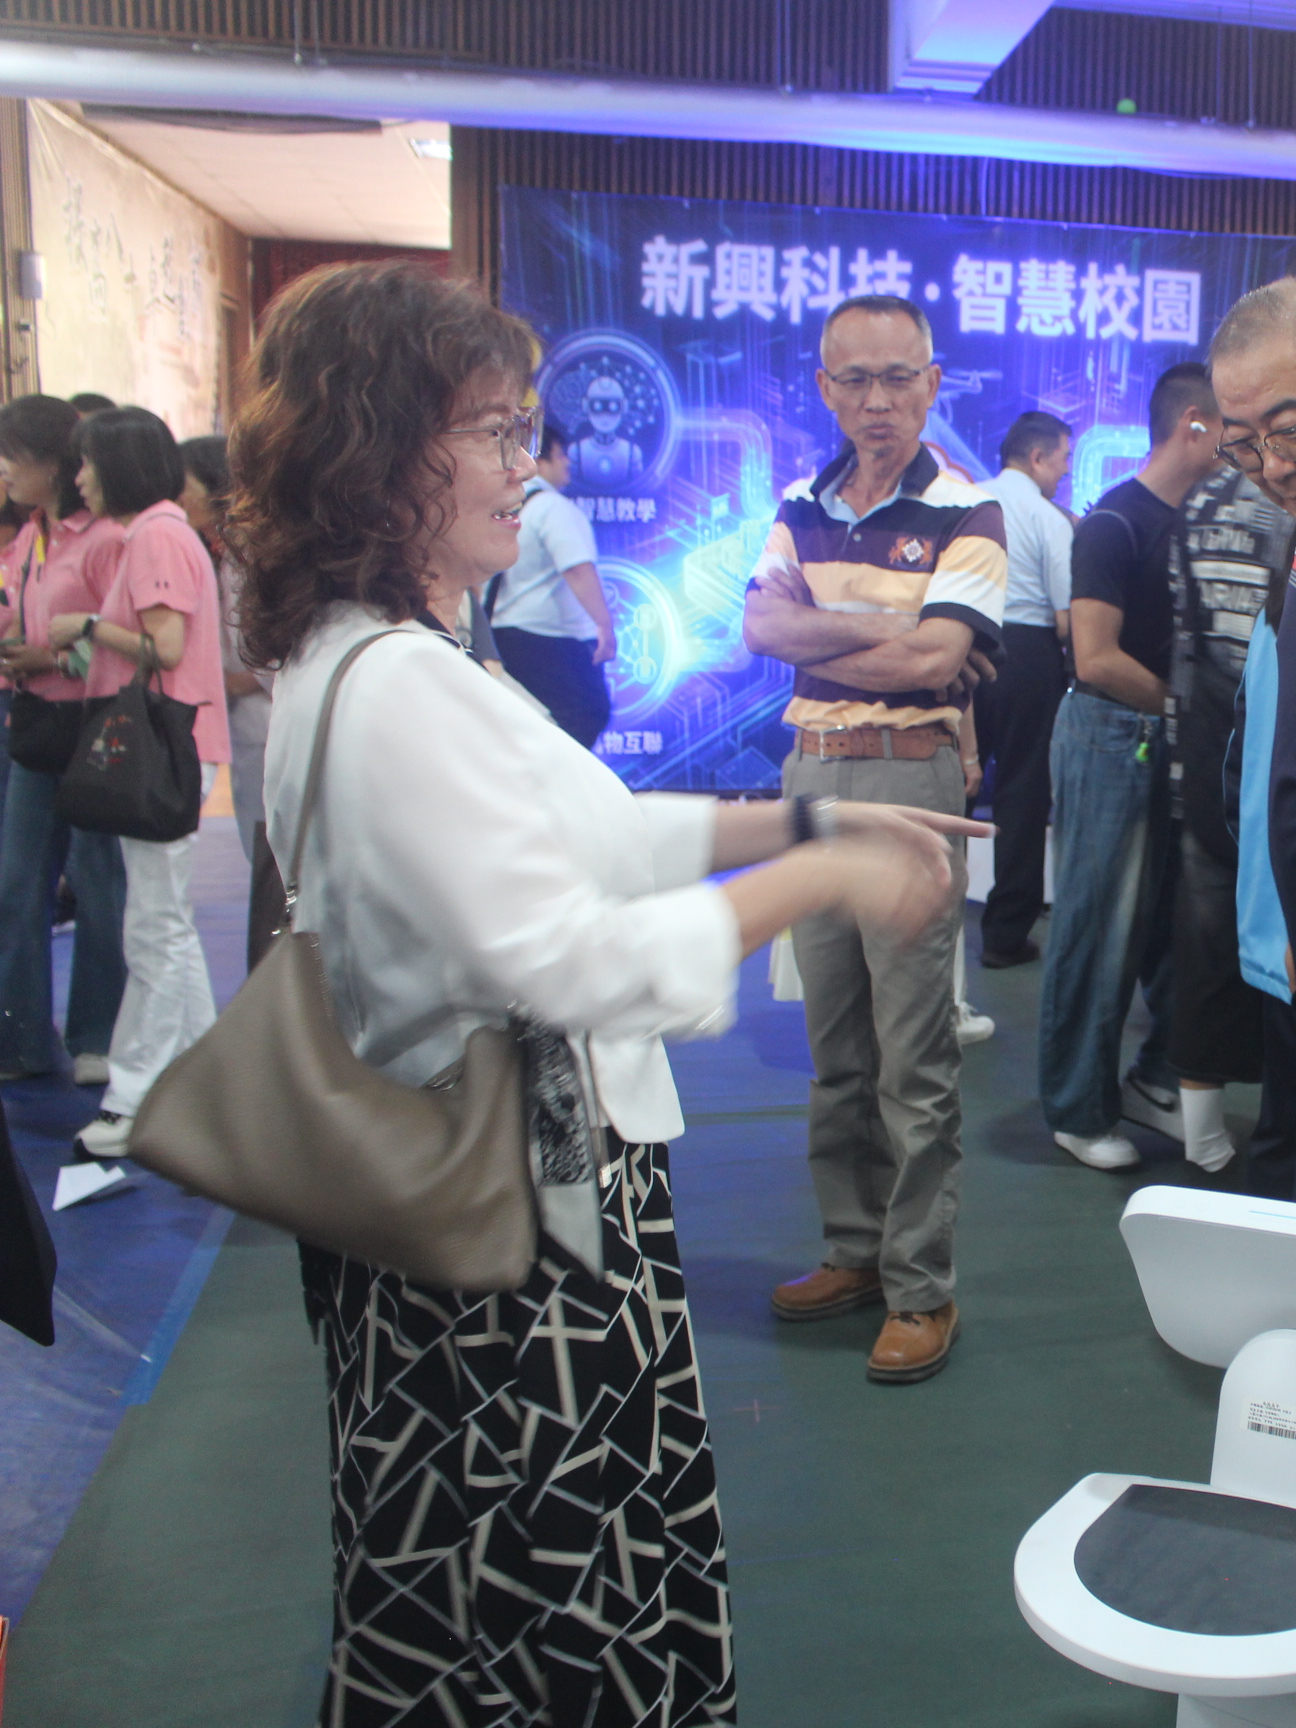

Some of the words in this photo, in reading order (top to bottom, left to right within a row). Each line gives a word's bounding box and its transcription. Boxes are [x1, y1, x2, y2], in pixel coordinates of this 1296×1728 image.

[641, 235, 1201, 345] 新興科技·智慧校園
